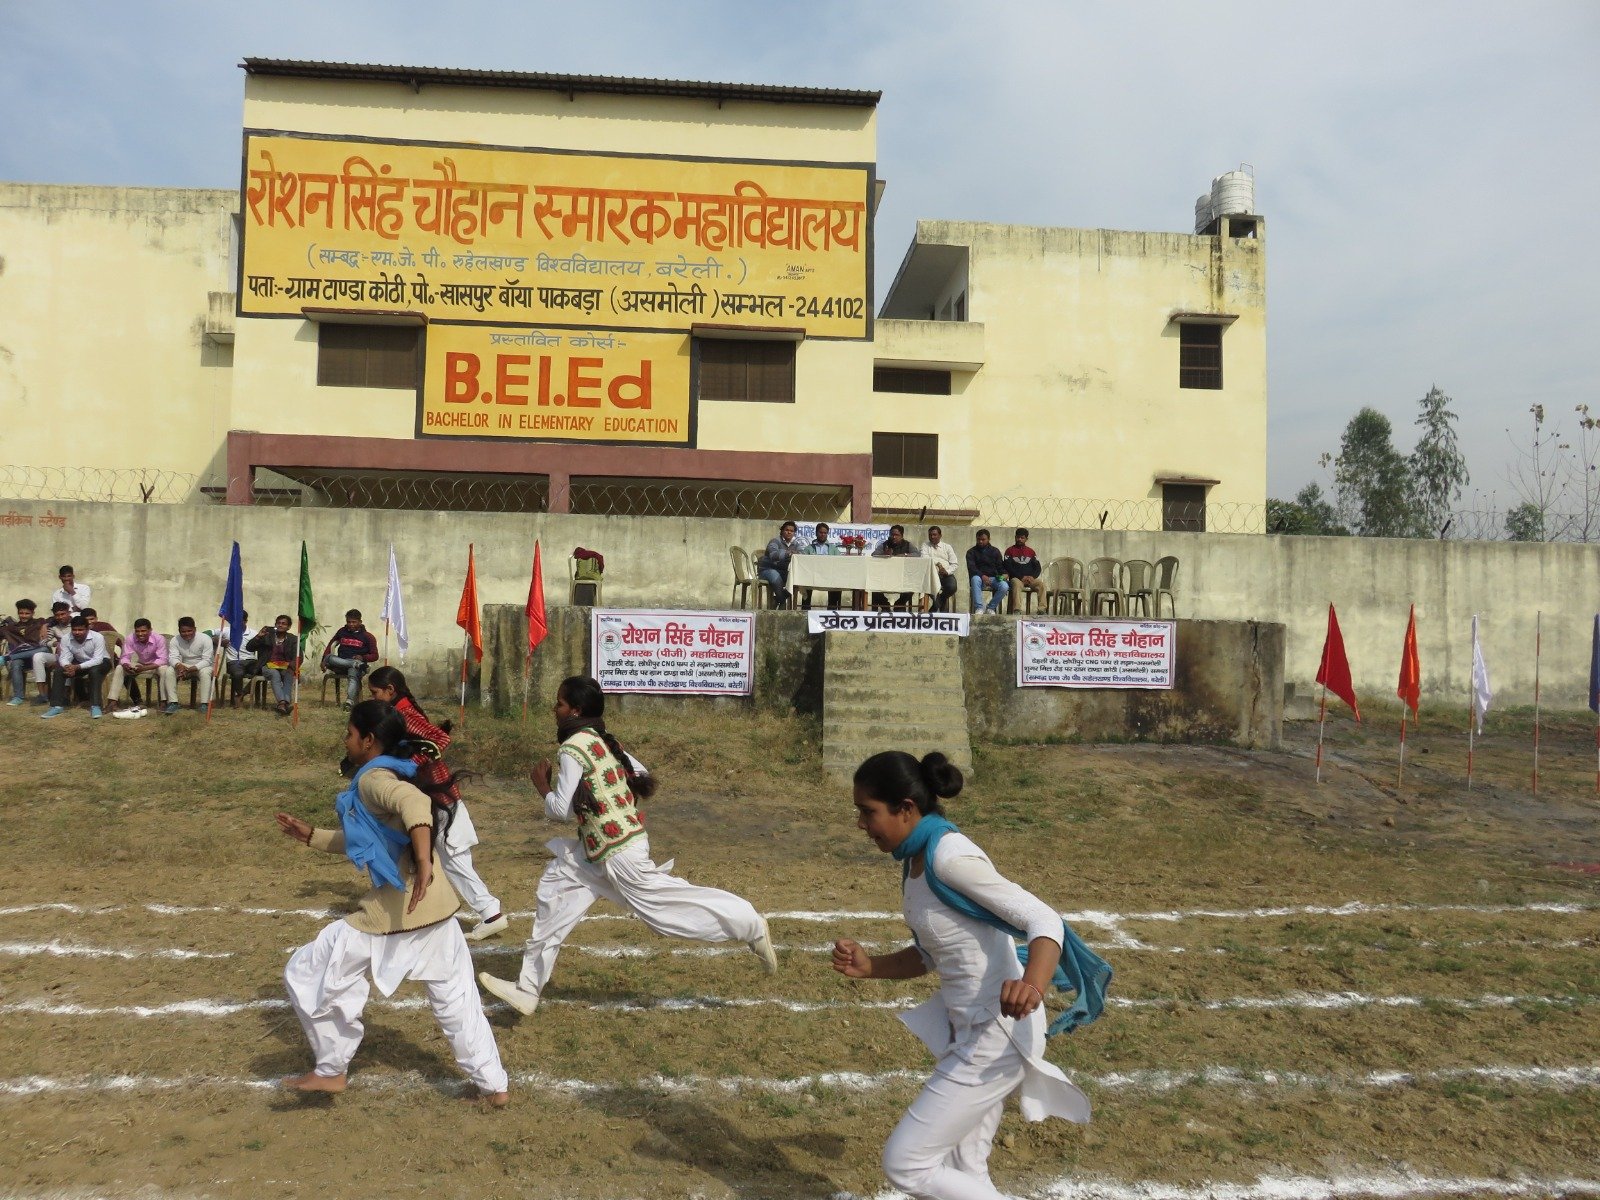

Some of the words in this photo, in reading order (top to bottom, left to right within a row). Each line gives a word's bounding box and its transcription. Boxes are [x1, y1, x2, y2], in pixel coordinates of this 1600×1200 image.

[247, 150, 338, 228] रोशन
[340, 155, 410, 240] सिंह
[412, 157, 529, 244] चौहान
[533, 184, 676, 246] स्मारक
[673, 180, 866, 252] महाविद्यालय
[489, 330, 562, 347] प्रस्तावित
[426, 411, 489, 429] BACHELOR
[498, 413, 512, 429] IN
[519, 415, 595, 432] ELEMENTARY
[604, 416, 678, 433] EDUCATION
[819, 611, 859, 630] खेल
[863, 612, 960, 631] प्रतियोगिता
[621, 622, 661, 644] रोशन
[665, 622, 695, 646] सिंह
[699, 623, 744, 647] चौहान
[1046, 627, 1085, 645] रोशन
[1088, 627, 1118, 648] सिंह
[1121, 629, 1165, 648] चौहान
[690, 649, 744, 659] महाविद्यालय
[1113, 650, 1165, 659] महाविद्यालय
